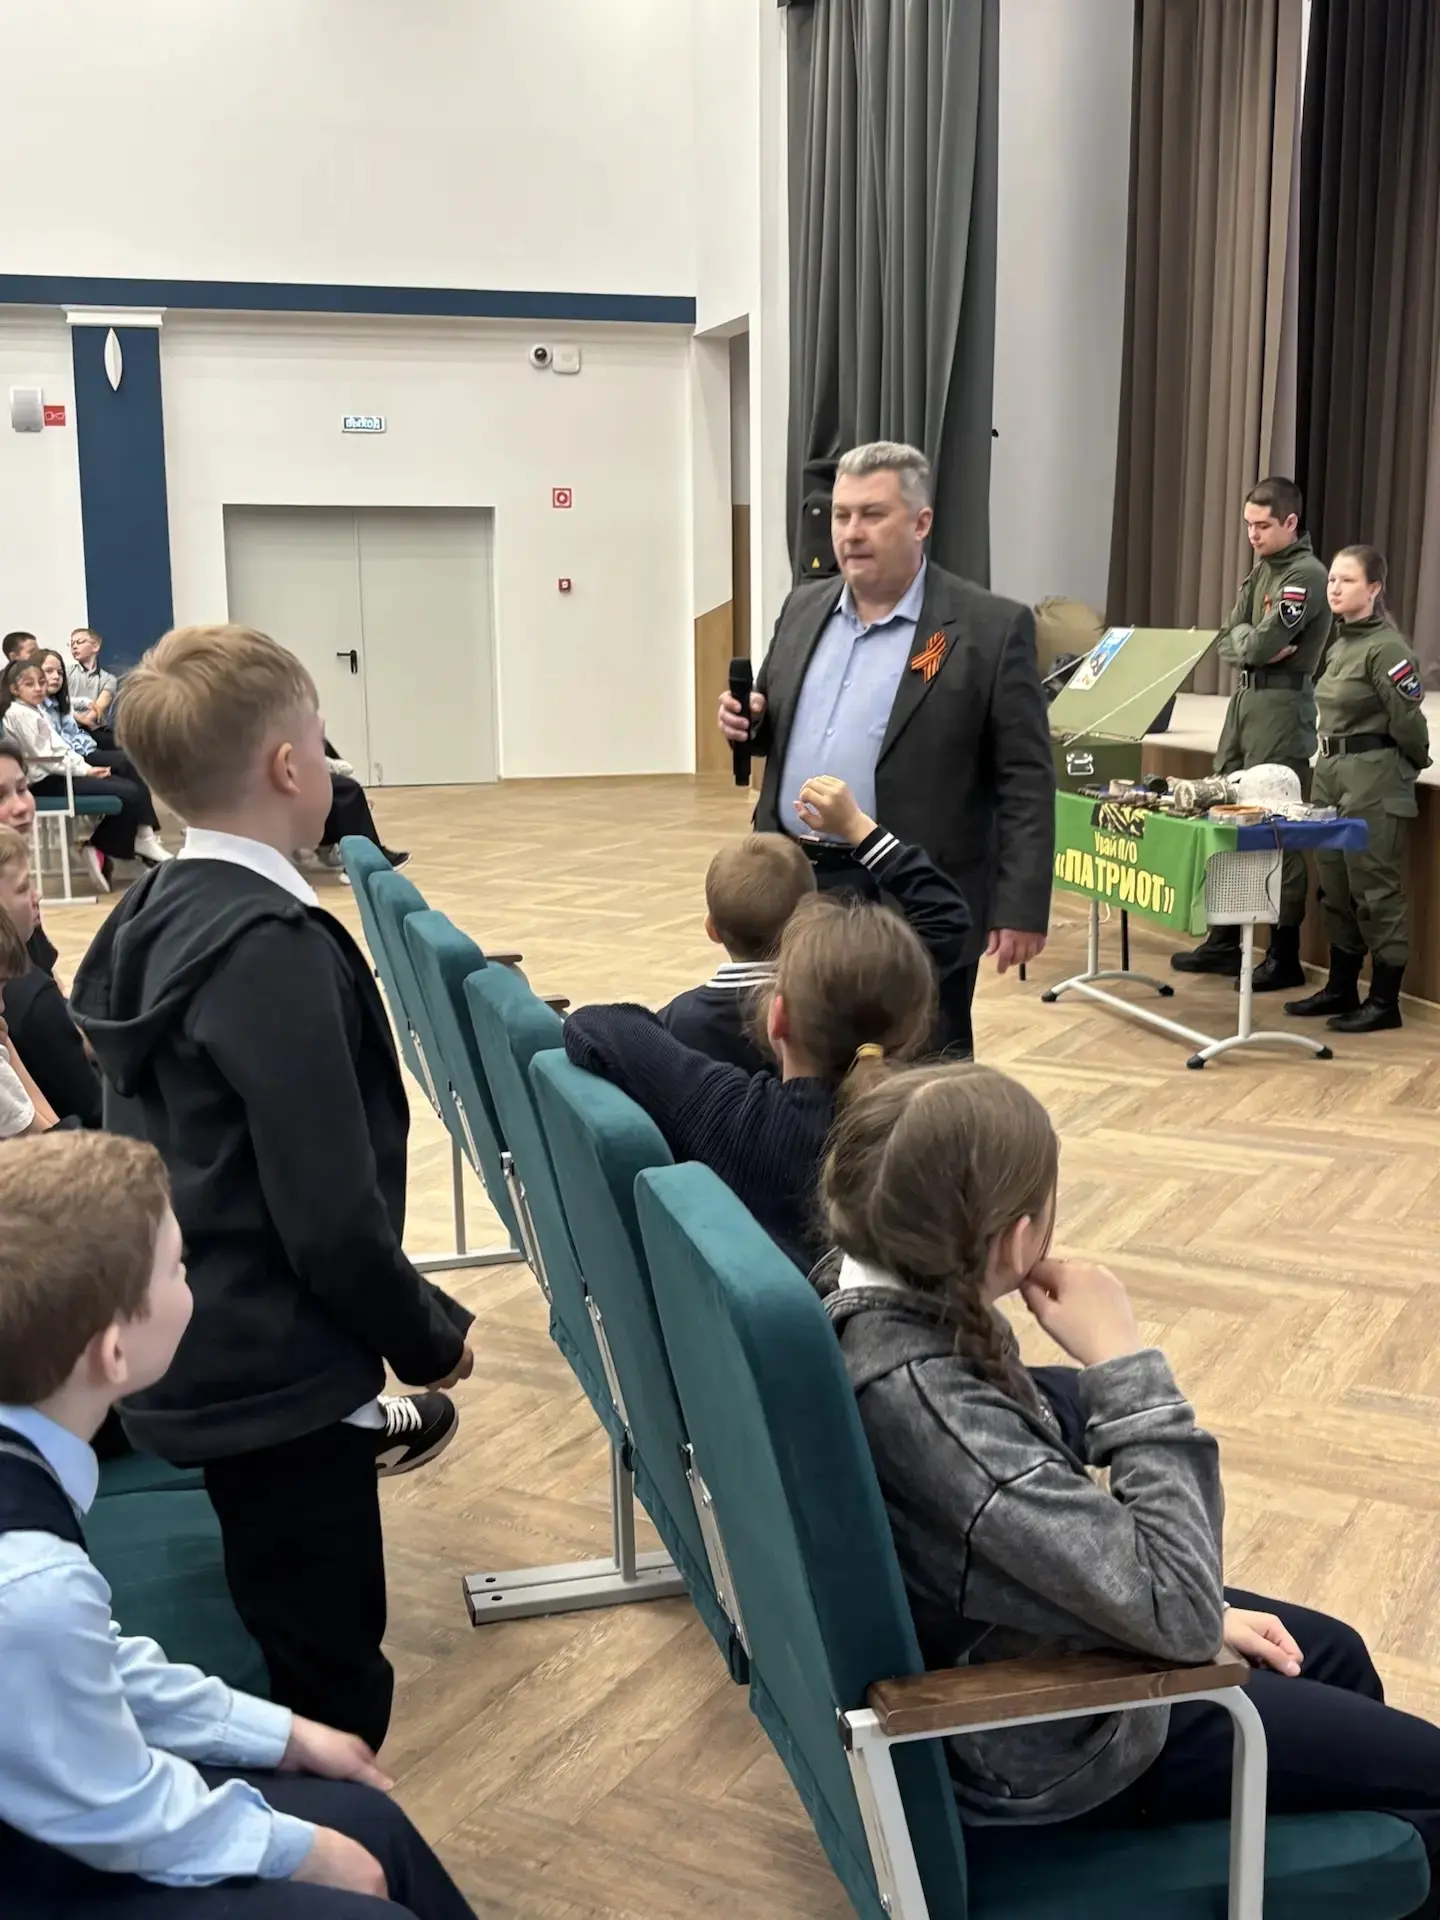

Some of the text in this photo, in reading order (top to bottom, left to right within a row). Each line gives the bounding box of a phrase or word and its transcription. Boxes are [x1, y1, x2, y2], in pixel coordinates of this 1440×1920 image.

[1094, 831, 1137, 864] Урай П/О
[1055, 848, 1175, 914] «ПАТРИОТ»
